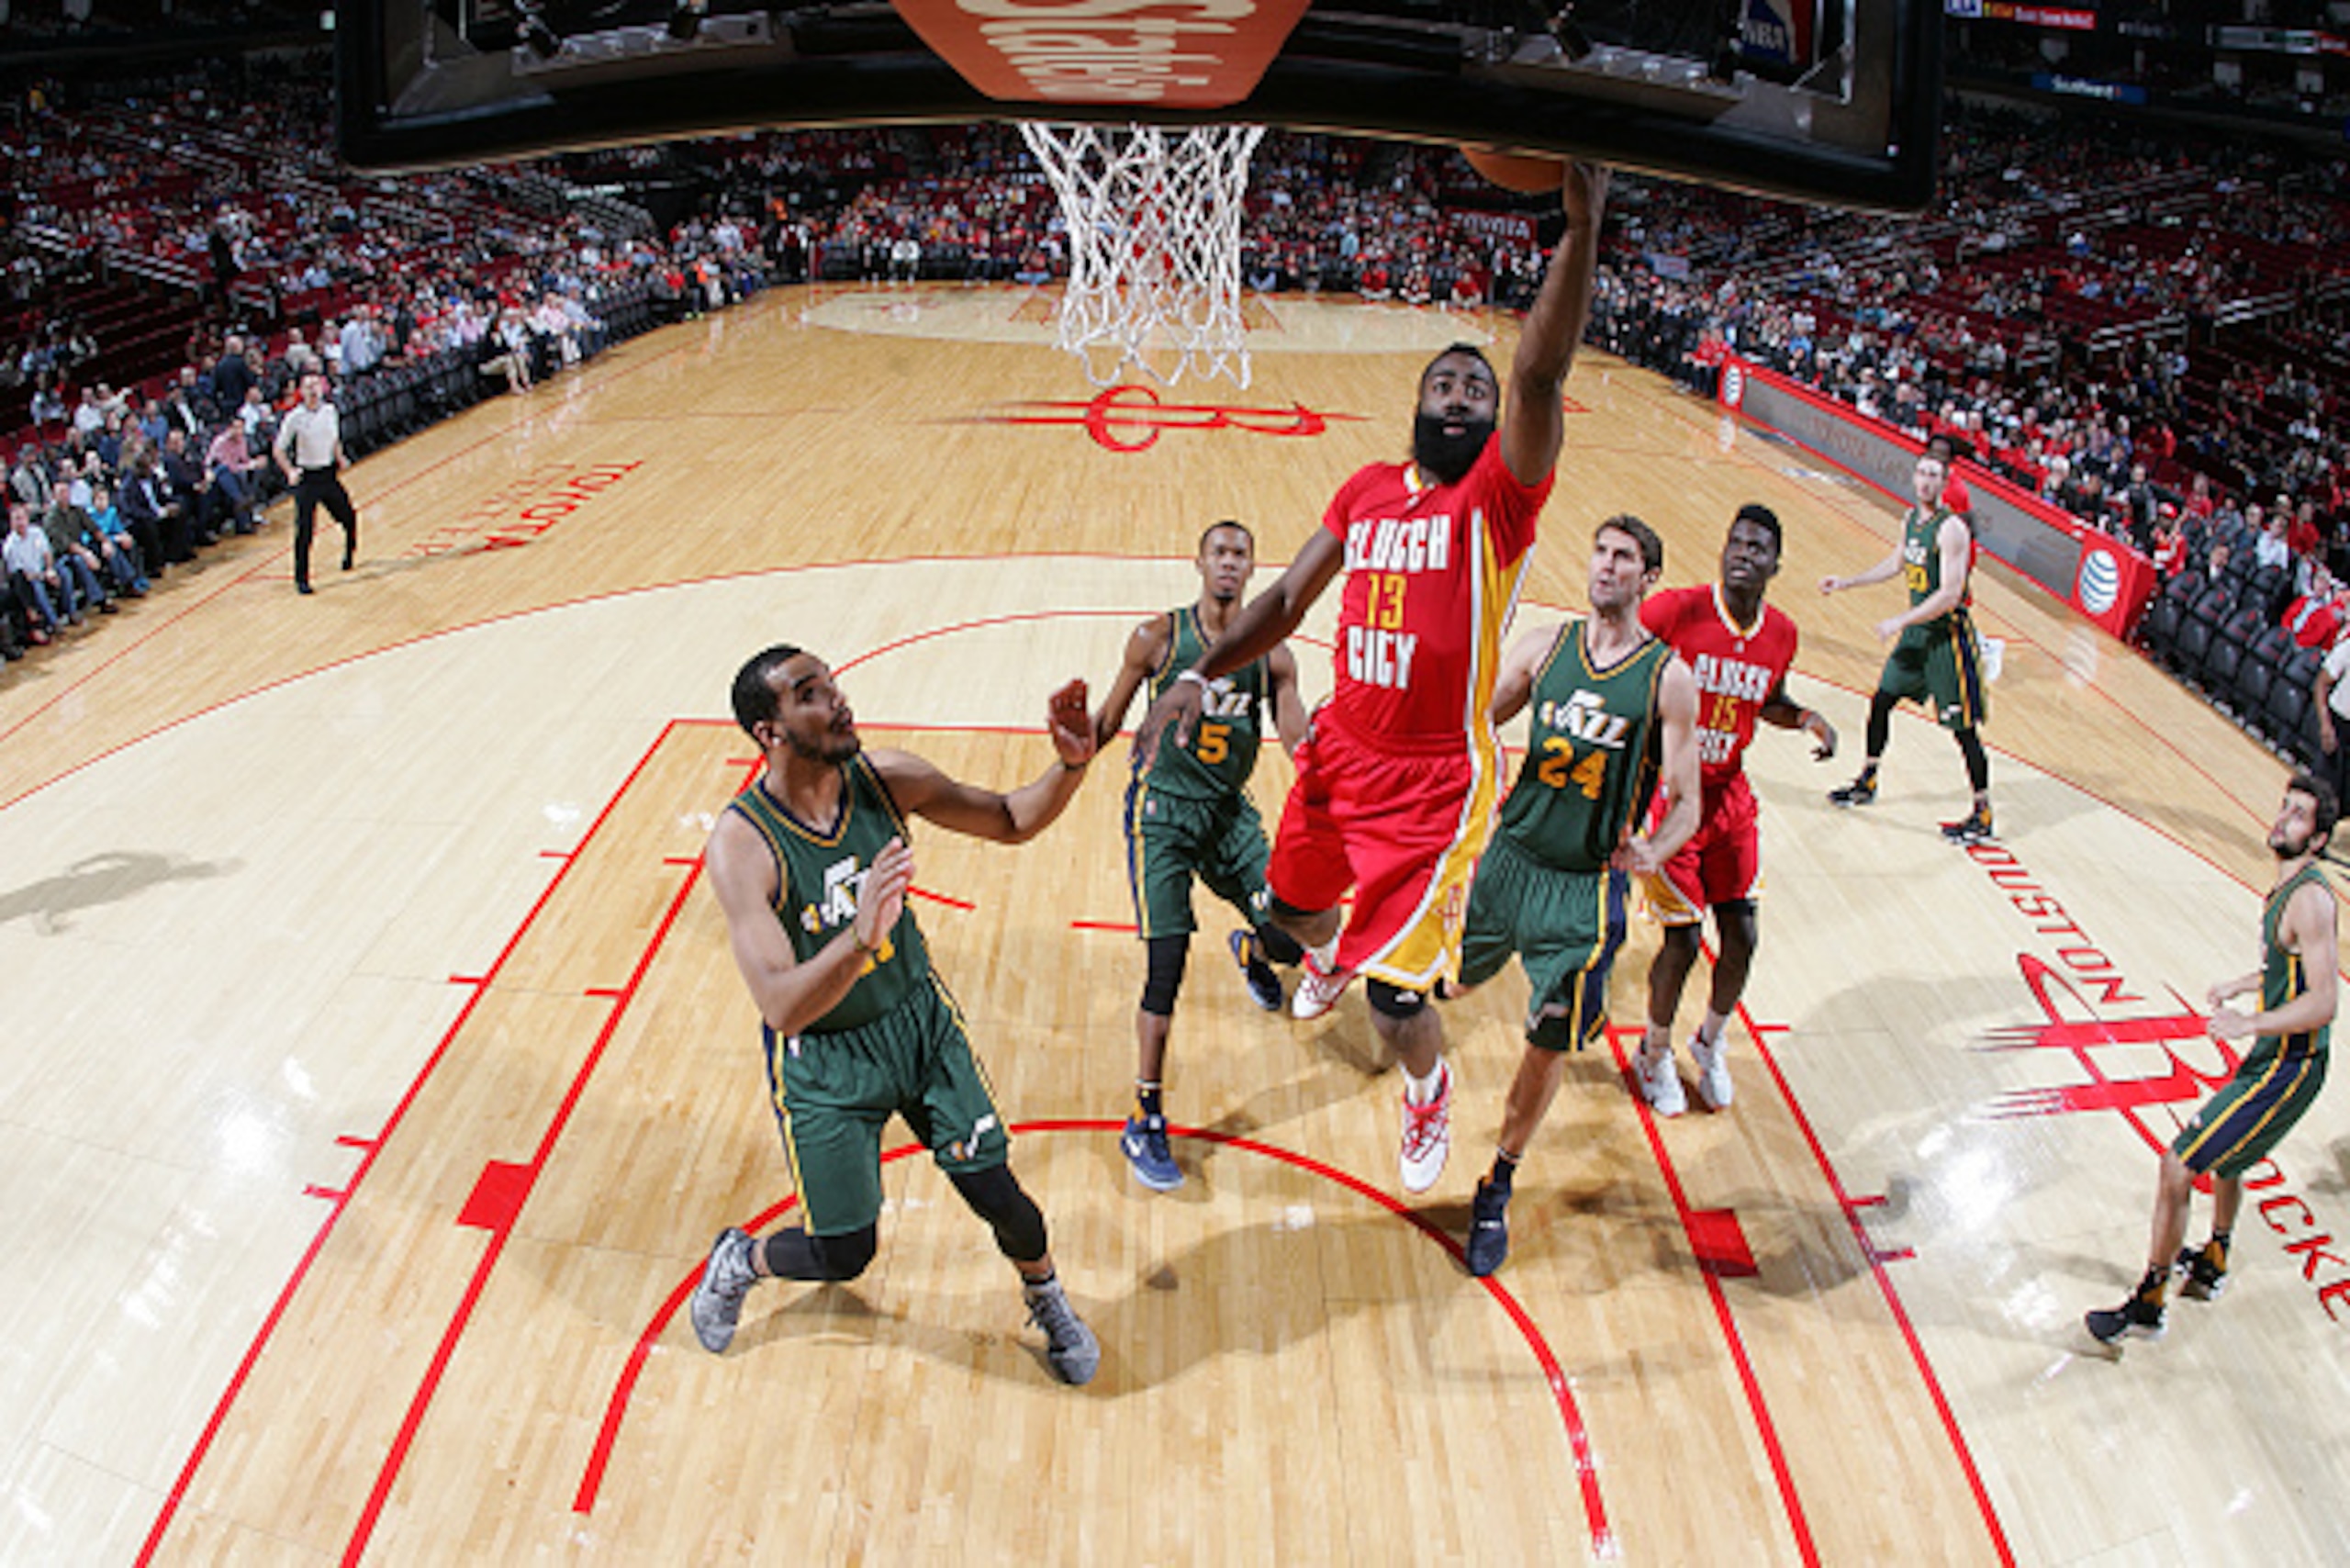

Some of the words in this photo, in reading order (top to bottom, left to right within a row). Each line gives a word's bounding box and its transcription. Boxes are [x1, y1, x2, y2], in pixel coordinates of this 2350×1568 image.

[956, 0, 1256, 75] State
[461, 460, 644, 555] TOYOTA
[1368, 573, 1406, 629] 13
[1348, 625, 1418, 689] CITY
[1196, 722, 1232, 764] 5
[1539, 689, 1630, 749] JAZZ
[1709, 695, 1740, 733] 15
[1539, 735, 1607, 800] 24
[1965, 837, 2146, 1004] OUSTON
